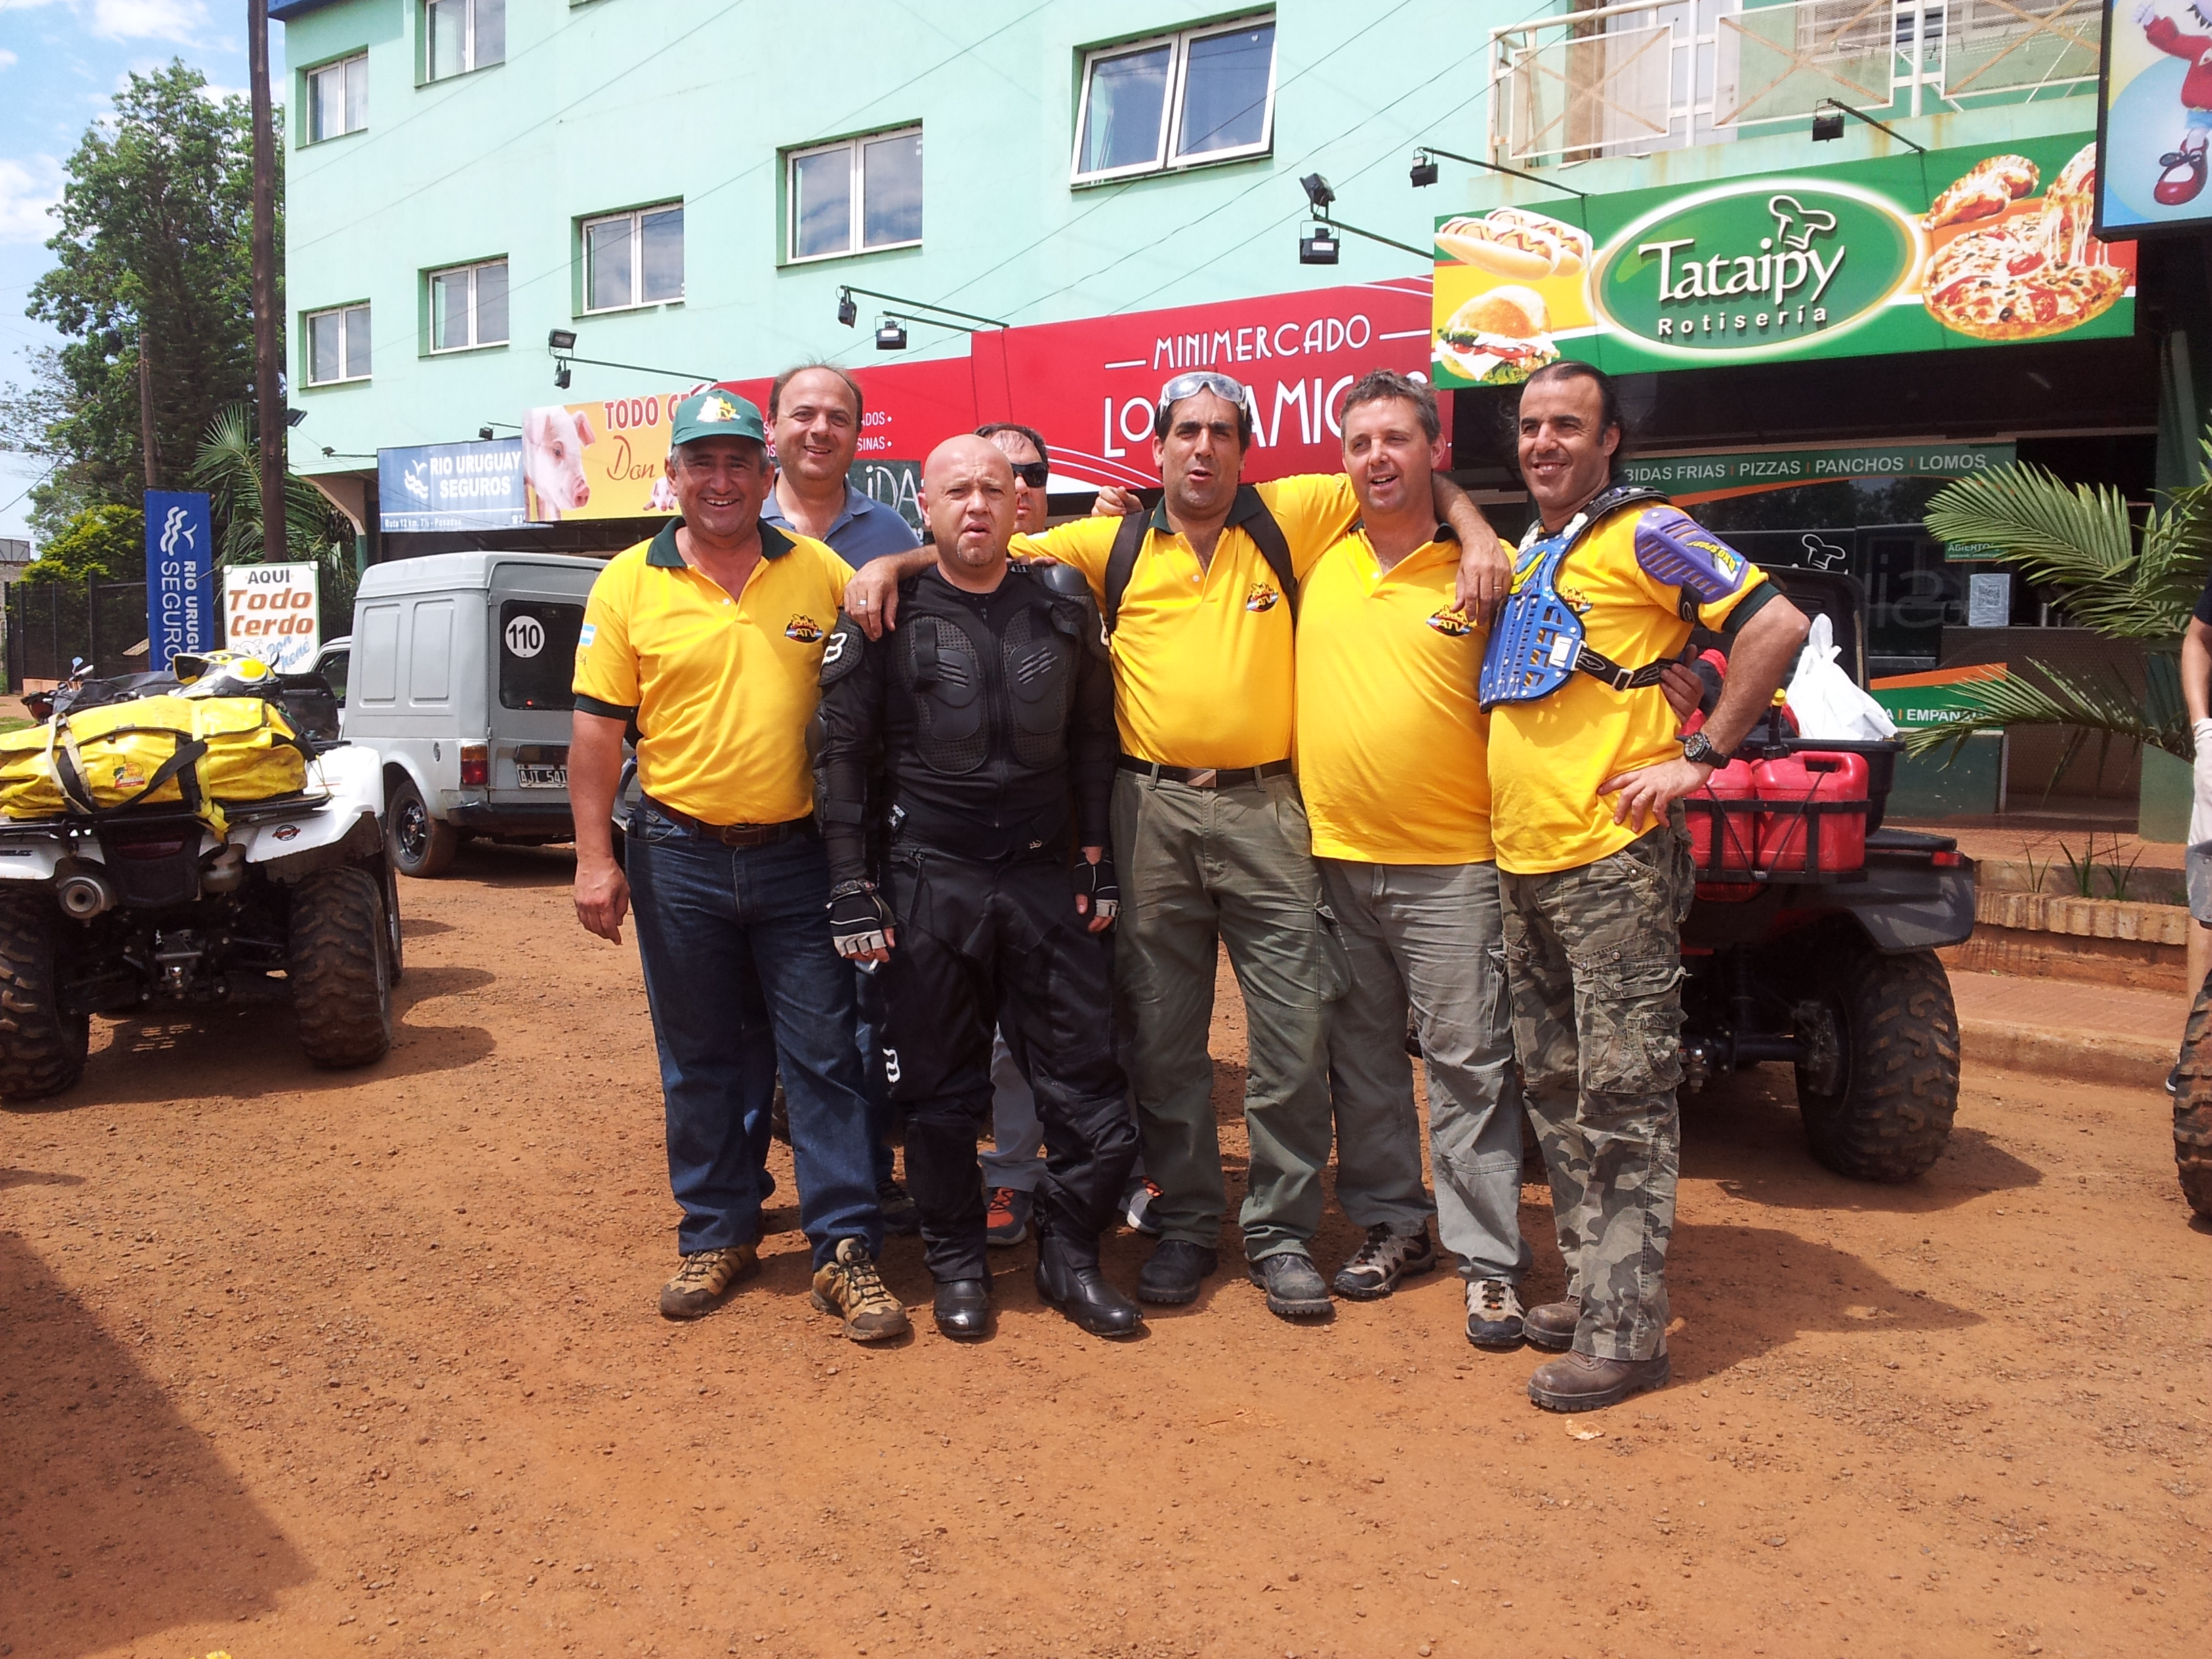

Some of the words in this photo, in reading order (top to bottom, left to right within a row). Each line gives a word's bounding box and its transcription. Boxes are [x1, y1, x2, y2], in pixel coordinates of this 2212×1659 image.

[1638, 237, 1846, 306] Tataipy
[1658, 304, 1827, 336] Rotisería
[1153, 313, 1372, 371] MINIMERCADO
[605, 395, 661, 431] TODO
[1104, 396, 1155, 458] LO
[430, 456, 453, 475] RIO
[456, 451, 522, 474] URUGUAY
[607, 434, 656, 481] Don
[1676, 464, 1726, 480] FRIAS
[1739, 460, 1801, 477] PIZZAS
[1815, 456, 1904, 474] PANCHOS
[1919, 453, 1987, 470] LOMOS
[440, 476, 511, 498] SEGUROS
[385, 518, 399, 528] Ruta
[434, 517, 462, 527] Posadas
[183, 560, 197, 592] RIO
[247, 567, 291, 586] AQUÍ
[228, 587, 313, 611] Todo
[160, 560, 183, 672] SEGURO
[184, 596, 200, 655] URUGU
[230, 613, 314, 637] Cerdo
[1437, 618, 1465, 632] ATV
[508, 623, 541, 649] 110
[794, 628, 817, 638] ATV
